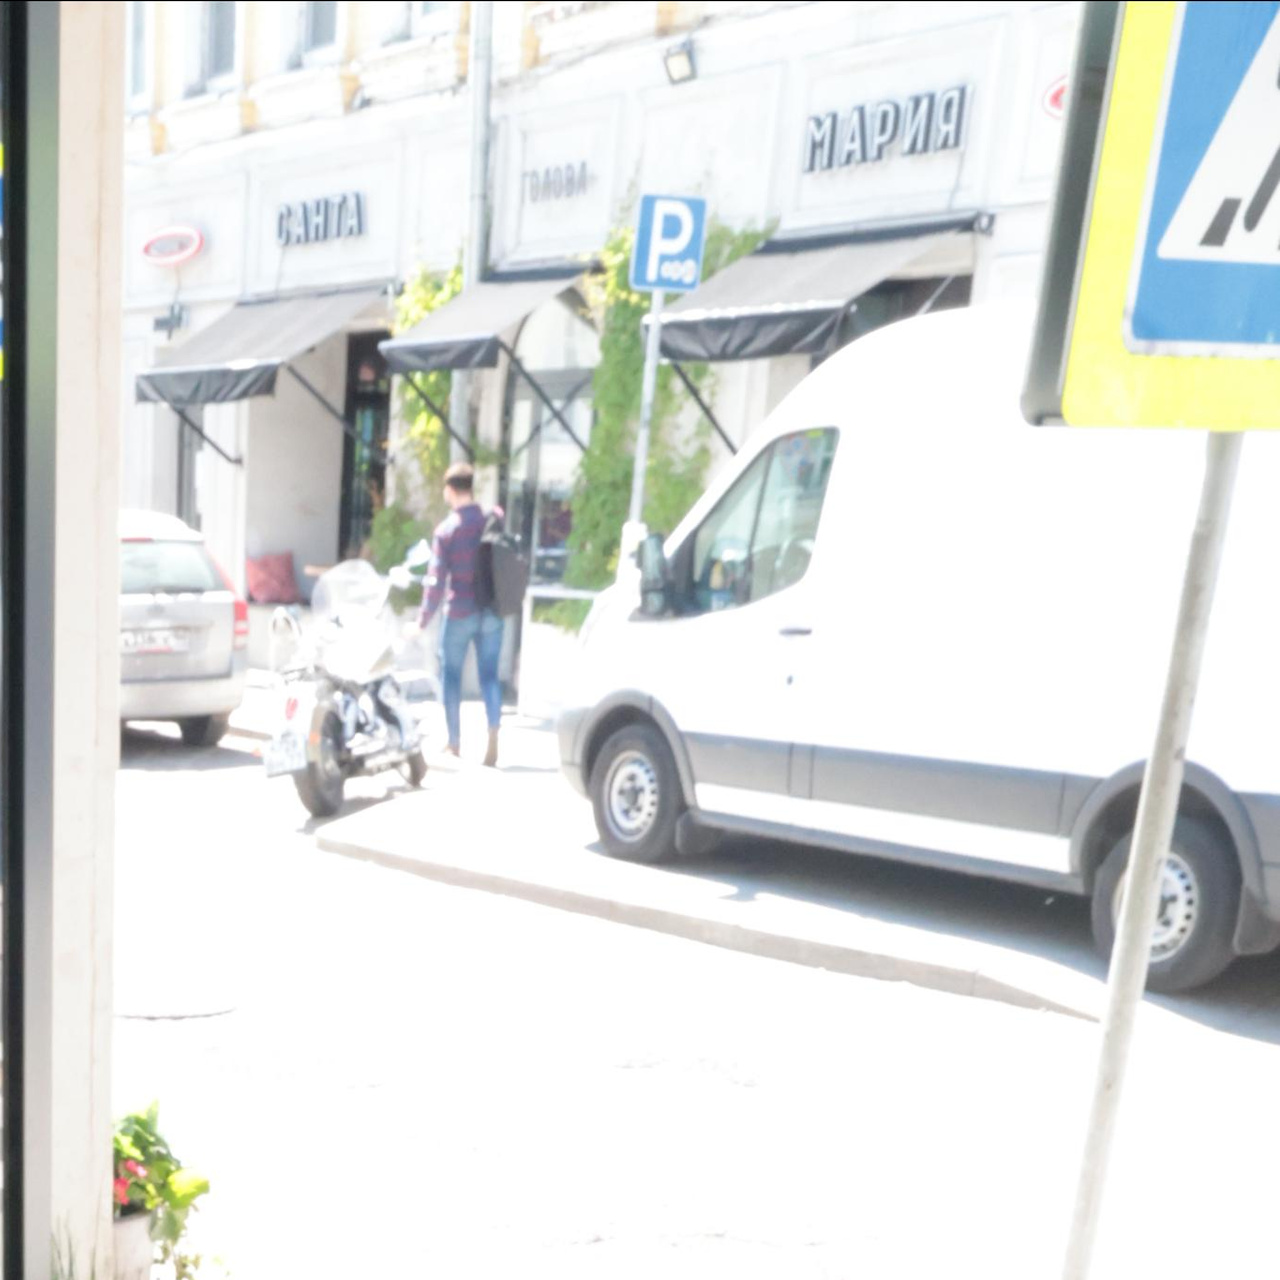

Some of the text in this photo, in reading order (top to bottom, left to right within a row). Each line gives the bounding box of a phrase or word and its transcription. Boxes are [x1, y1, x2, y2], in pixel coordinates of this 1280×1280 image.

[803, 84, 972, 174] МАРИЯ
[277, 190, 366, 246] САНТА
[646, 199, 694, 282] P
